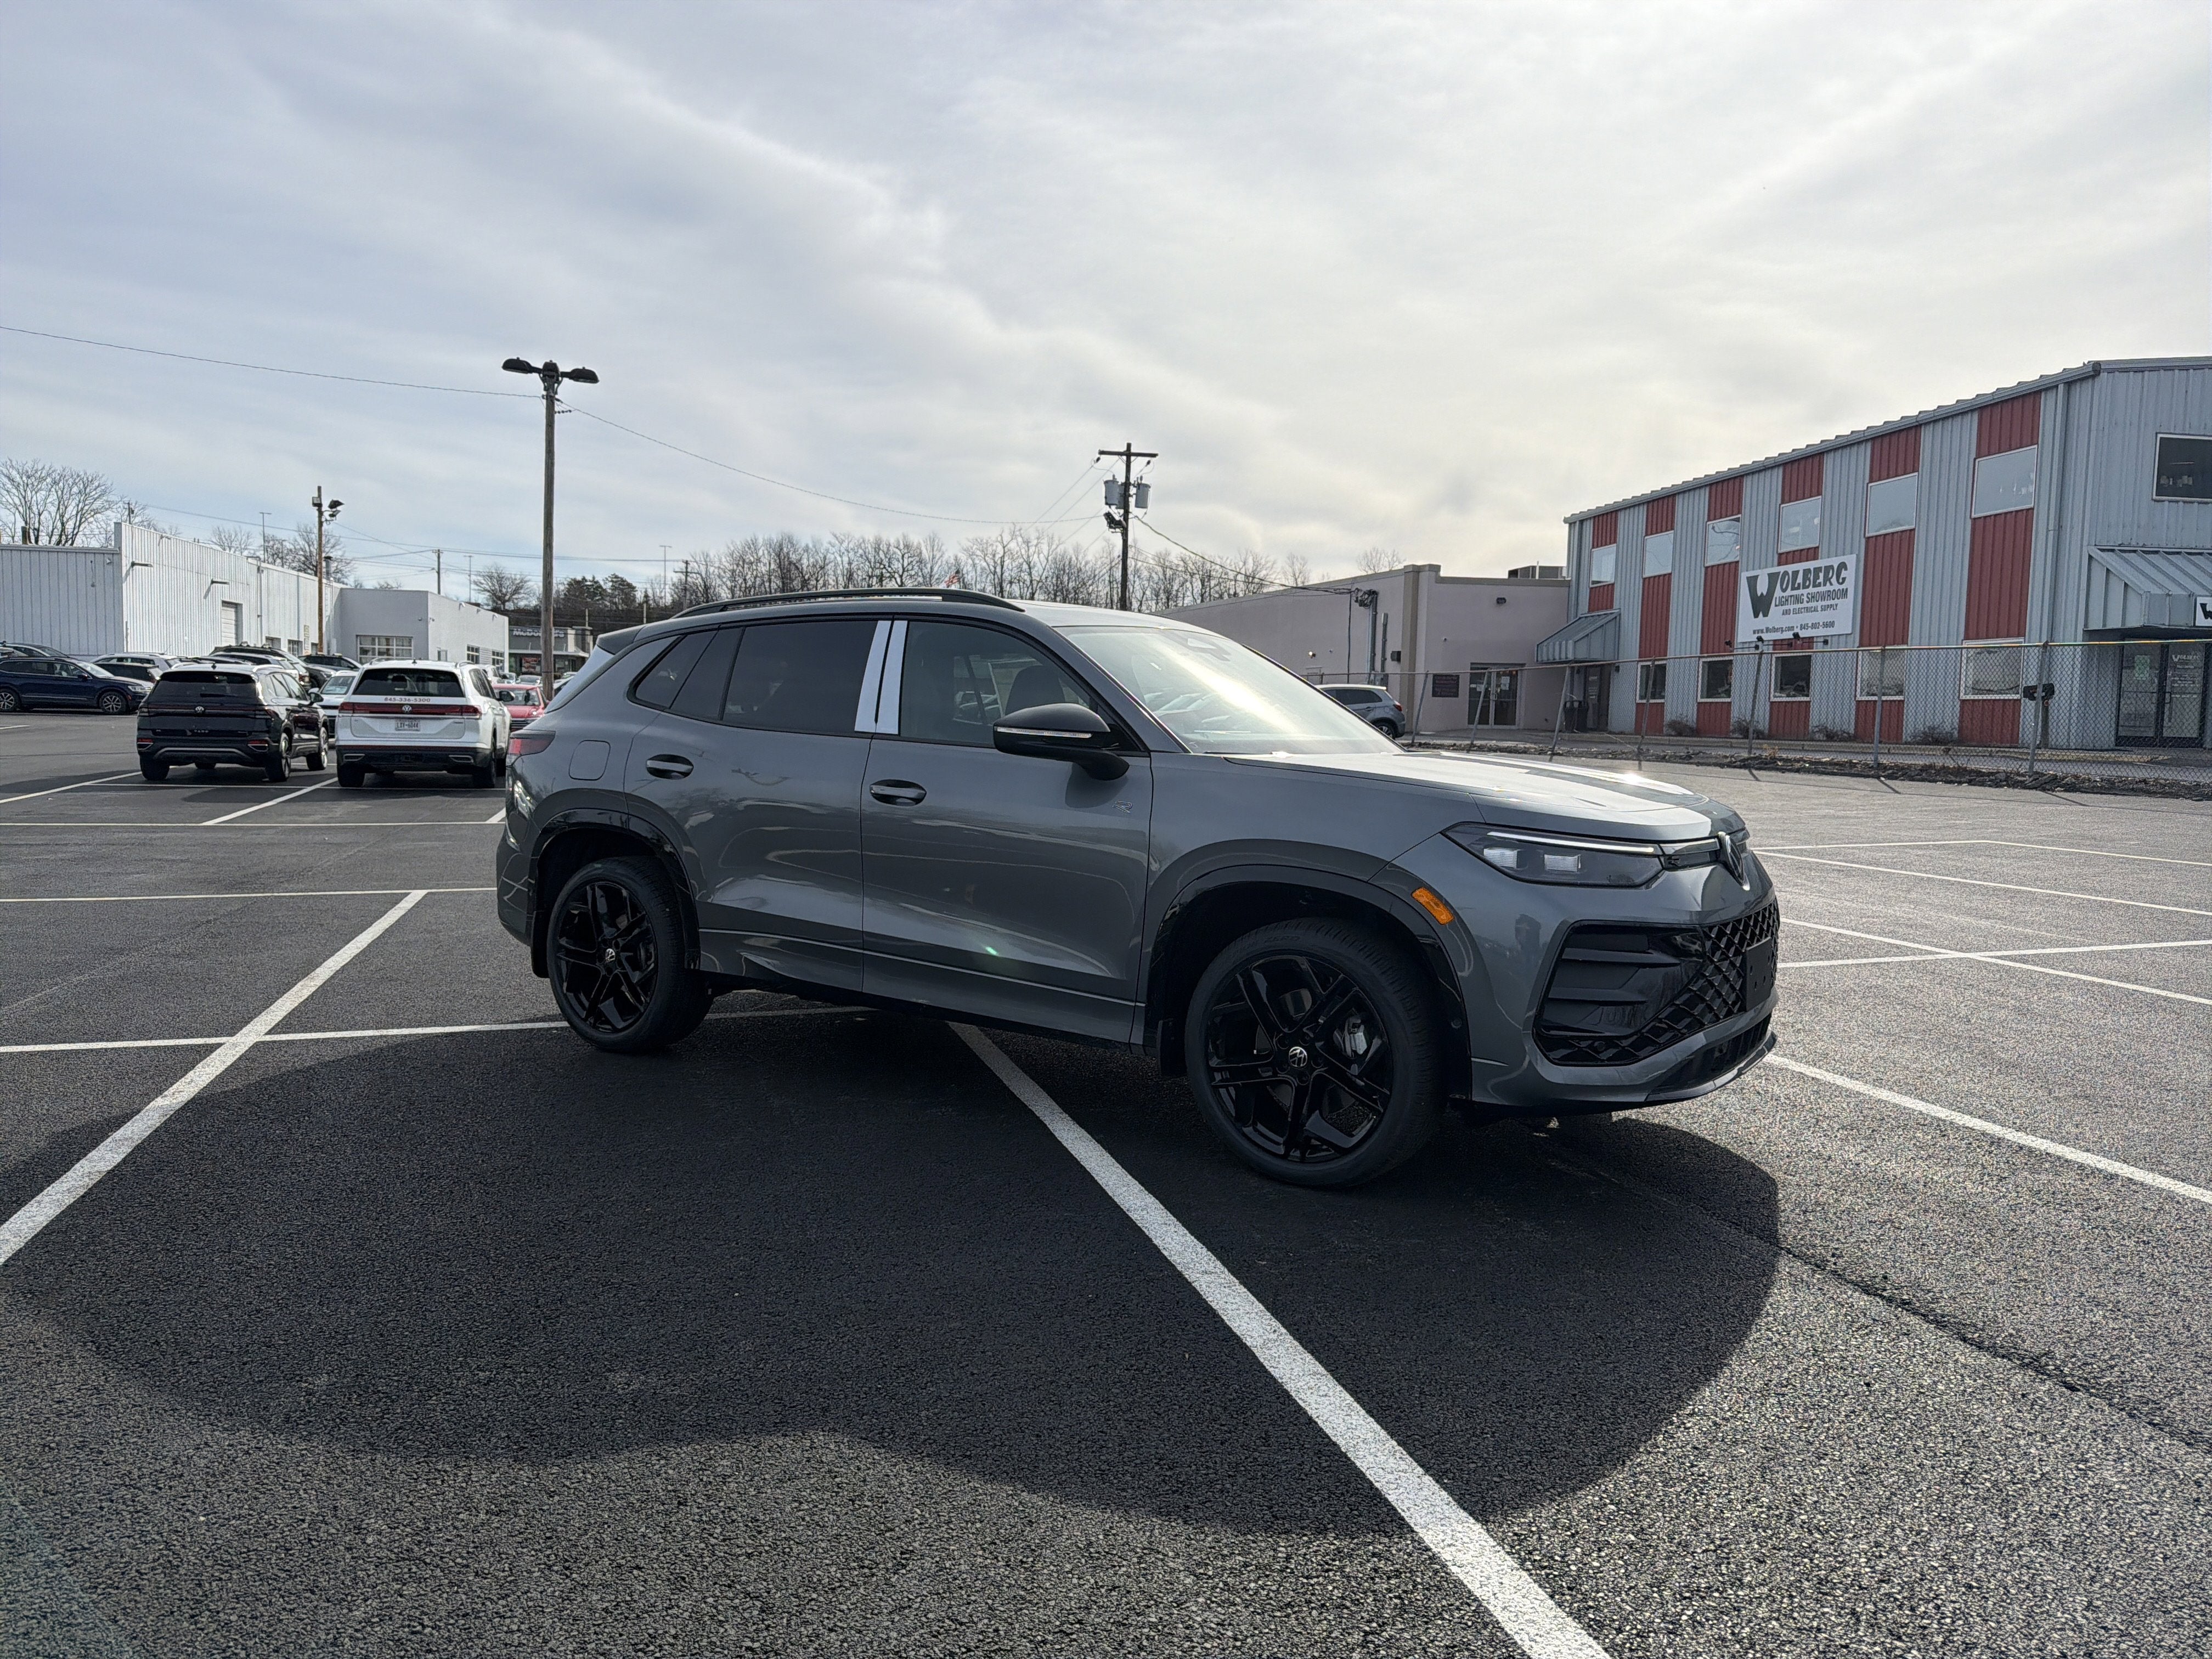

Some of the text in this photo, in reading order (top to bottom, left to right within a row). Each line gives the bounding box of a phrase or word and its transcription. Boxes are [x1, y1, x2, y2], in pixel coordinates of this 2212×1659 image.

[1746, 561, 1848, 619] WOLBERG
[1774, 588, 1848, 607] LIGHTING SHOWROOM
[1792, 605, 1819, 615] ELECTRICAL
[1820, 603, 1838, 612] SUPPLY
[1753, 620, 1835, 635] www.Wolberg.com 845-802-5600
